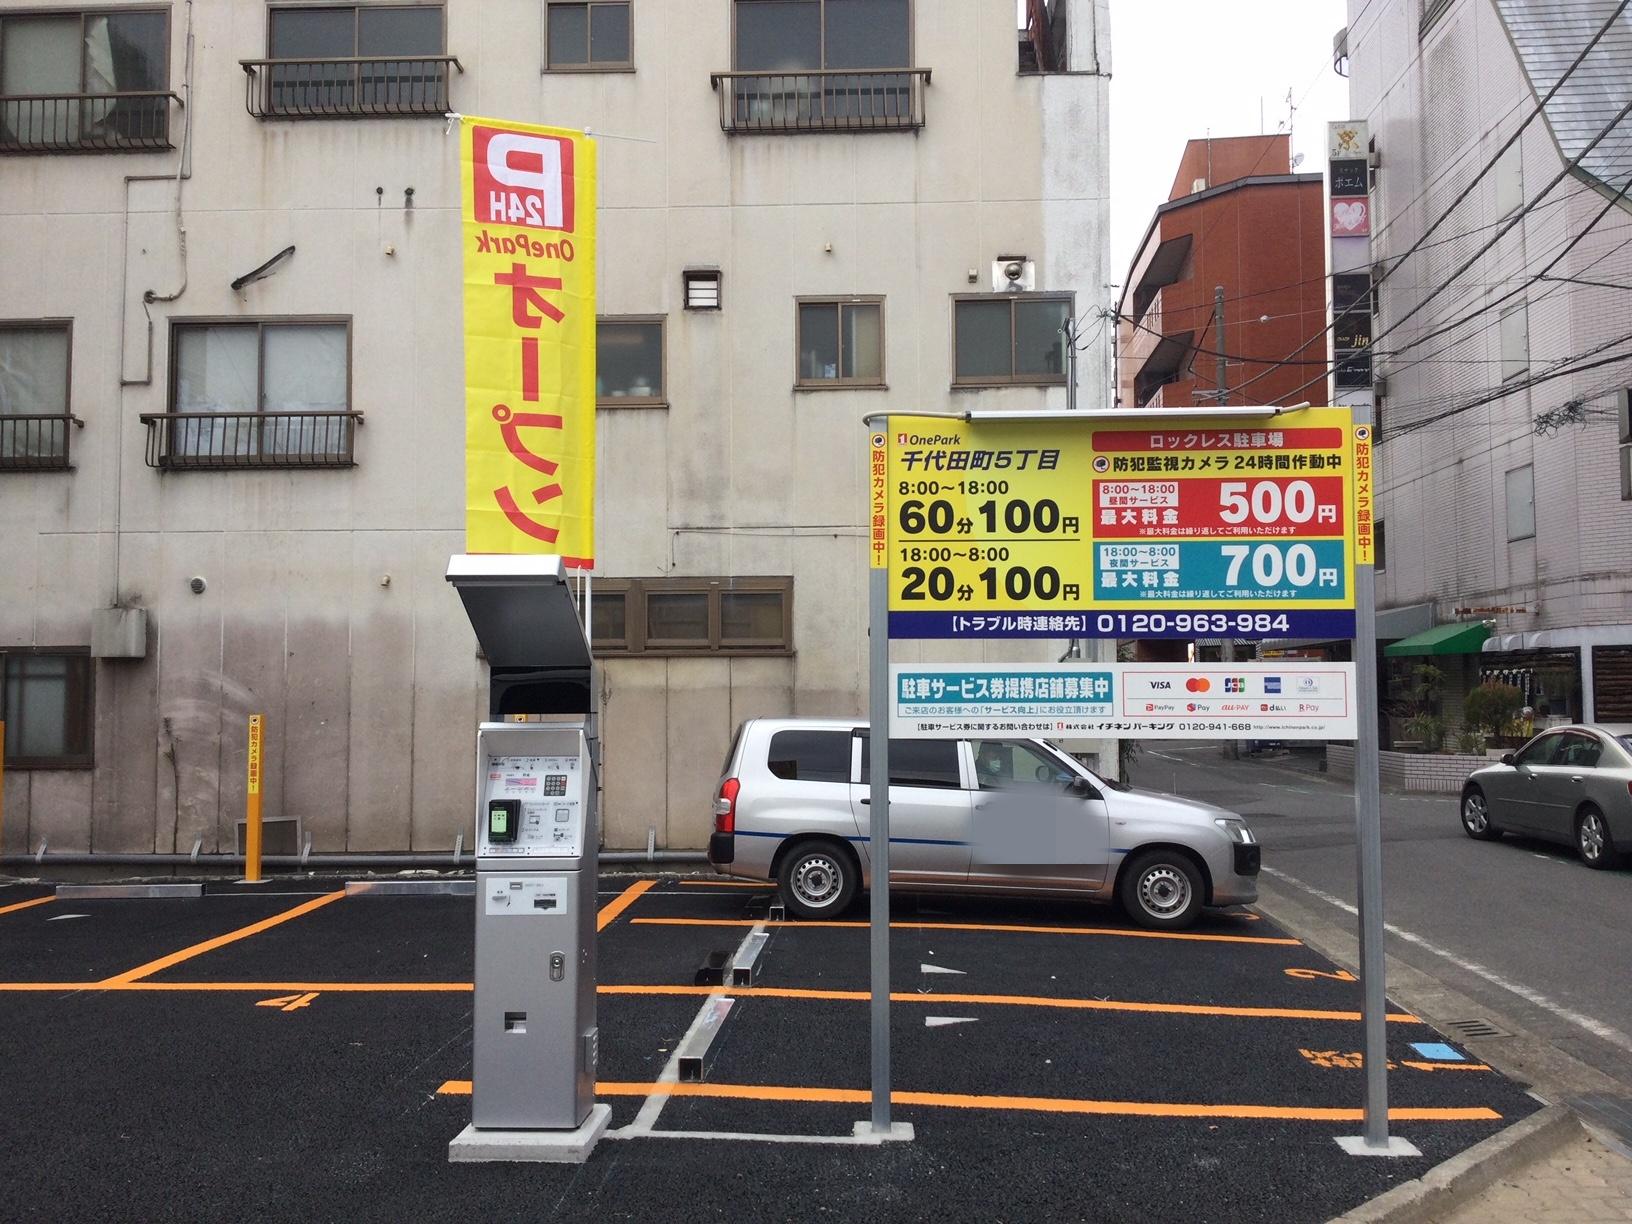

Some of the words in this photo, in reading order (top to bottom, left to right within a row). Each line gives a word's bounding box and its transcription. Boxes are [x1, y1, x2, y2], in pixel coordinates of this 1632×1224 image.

[909, 434, 961, 446] OnePark
[1150, 431, 1284, 448] ロックレス駐車場
[900, 449, 1061, 472] 千代田町5丁目
[1108, 495, 1169, 505] 昼間サービス
[1219, 480, 1337, 524] 500円
[1100, 508, 1179, 526] 最大料金
[1109, 558, 1170, 568] 夜間サービス
[1220, 543, 1338, 587] 700円
[1101, 571, 1180, 588] 最大料金
[1097, 613, 1290, 633] 0120-963-984
[901, 677, 1109, 699] 駐車サービス券提携店舗募集中
[1150, 681, 1171, 689] VISA
[1197, 704, 1210, 712] Pay
[1179, 723, 1251, 731] 0120-941-668
[255, 992, 320, 1011] 4
